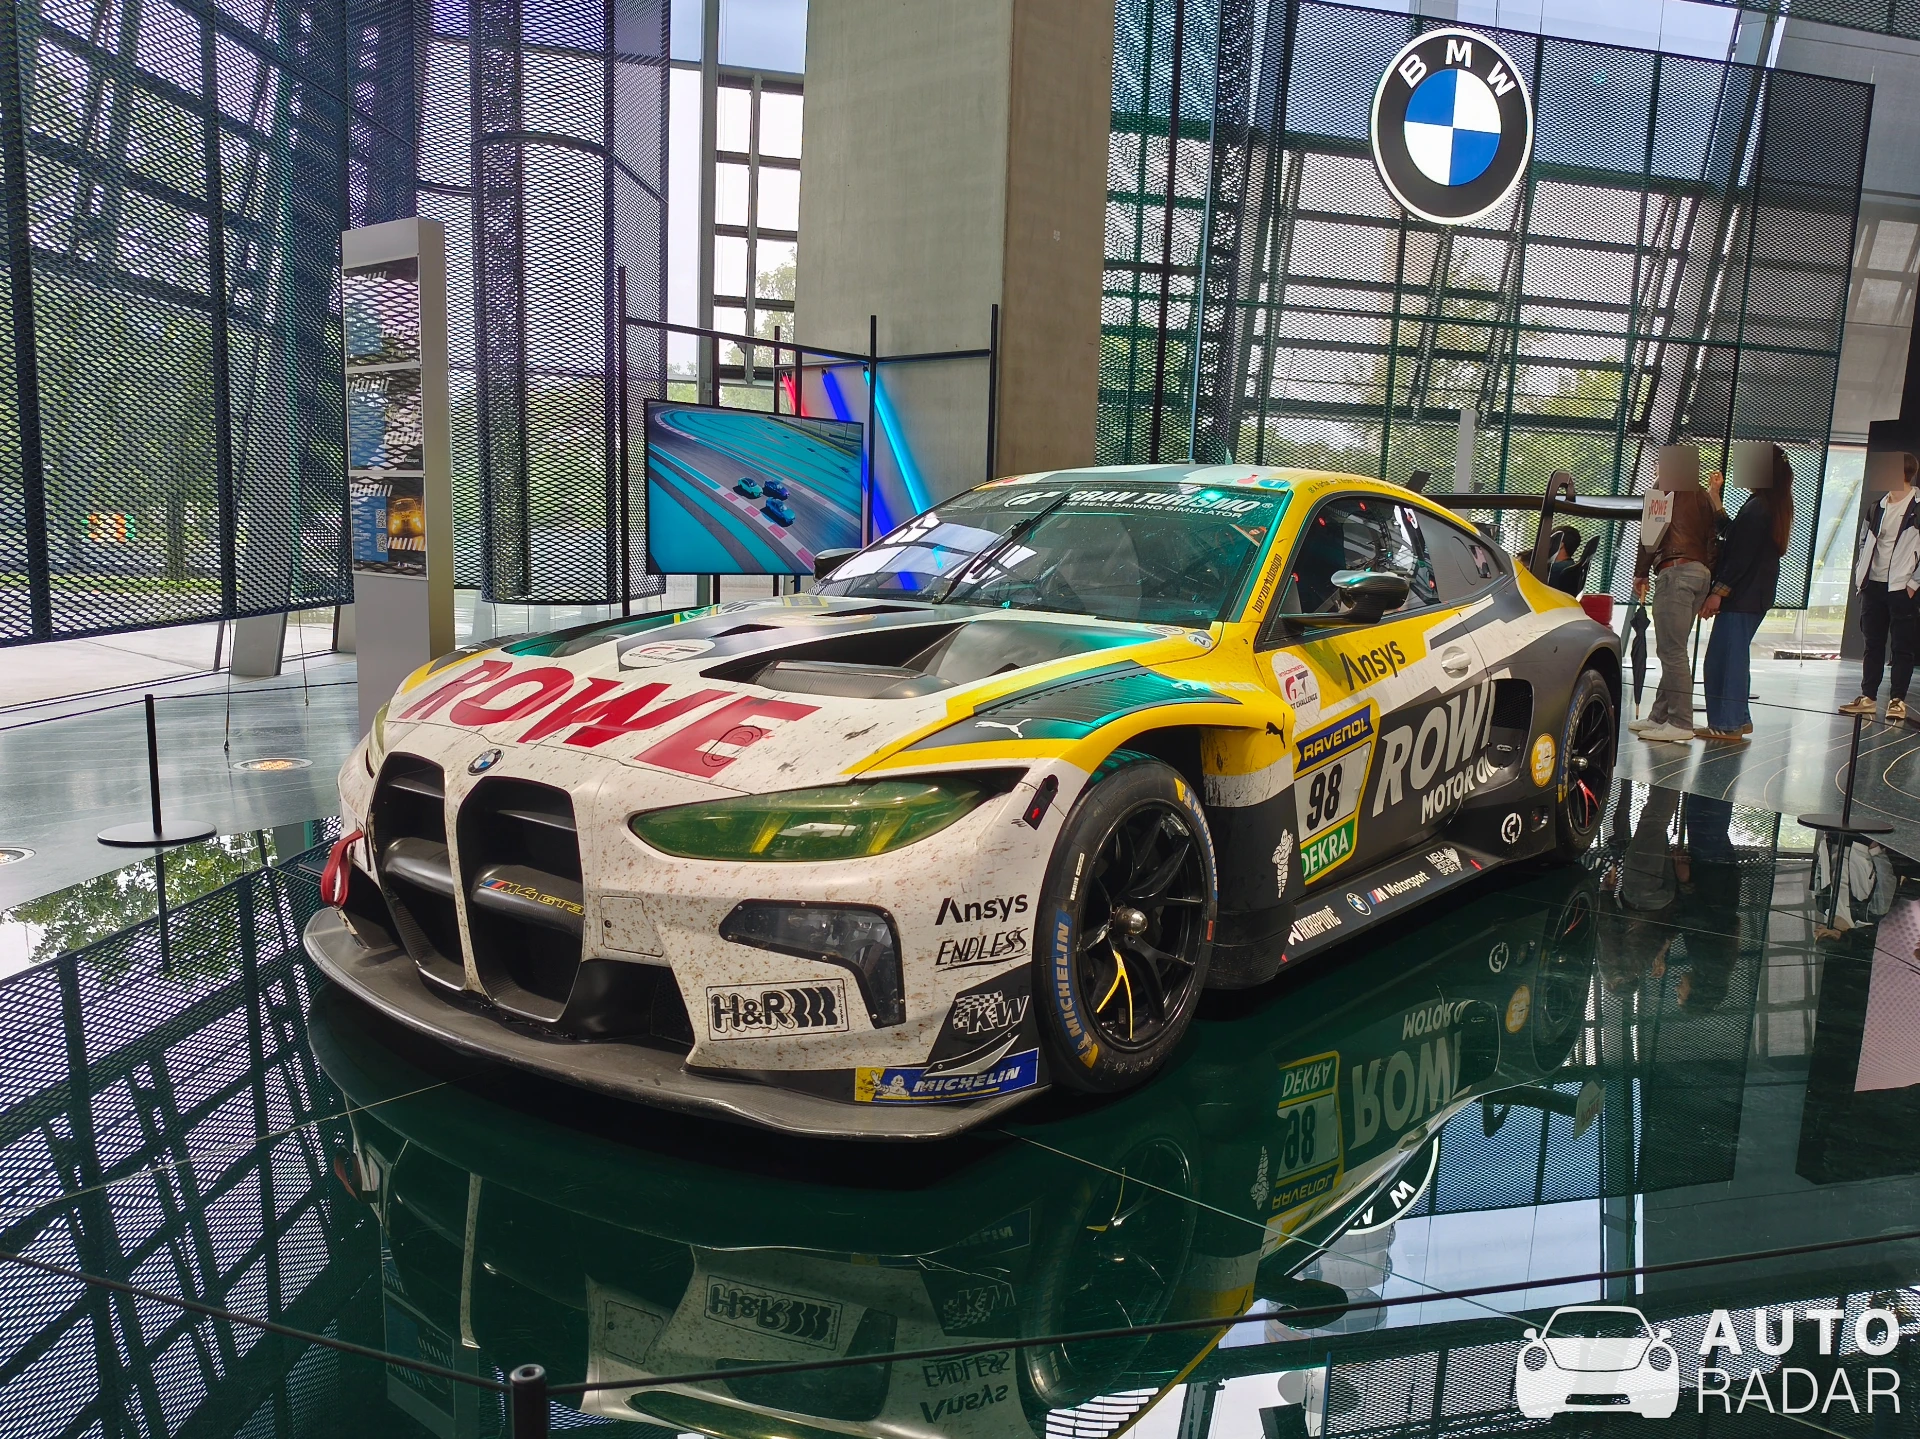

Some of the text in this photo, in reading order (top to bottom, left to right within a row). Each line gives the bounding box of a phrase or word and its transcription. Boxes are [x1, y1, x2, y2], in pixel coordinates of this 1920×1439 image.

[1398, 39, 1517, 98] BMW
[1068, 490, 1261, 513] GRAN TURISMO
[1112, 501, 1162, 512] DRIVING
[1164, 505, 1243, 519] SIMULATOR
[1339, 640, 1406, 692] Ansys
[398, 660, 823, 778] ROWE
[1296, 692, 1318, 709] CHALLENGE
[1304, 717, 1369, 761] RAVENOL
[1306, 763, 1343, 831] 98
[1421, 764, 1476, 825] MOTOR
[1301, 827, 1350, 878] DEKRA
[1425, 850, 1448, 865] MBA
[498, 881, 539, 901] M4
[1383, 870, 1431, 897] Motorsport
[935, 894, 1028, 926] Ansys
[935, 927, 1029, 968] ENDLESS
[1055, 921, 1083, 1038] MICHELIN
[712, 990, 792, 1032] H&R
[966, 994, 1030, 1035] KW
[912, 1066, 1022, 1094] MICHELIN
